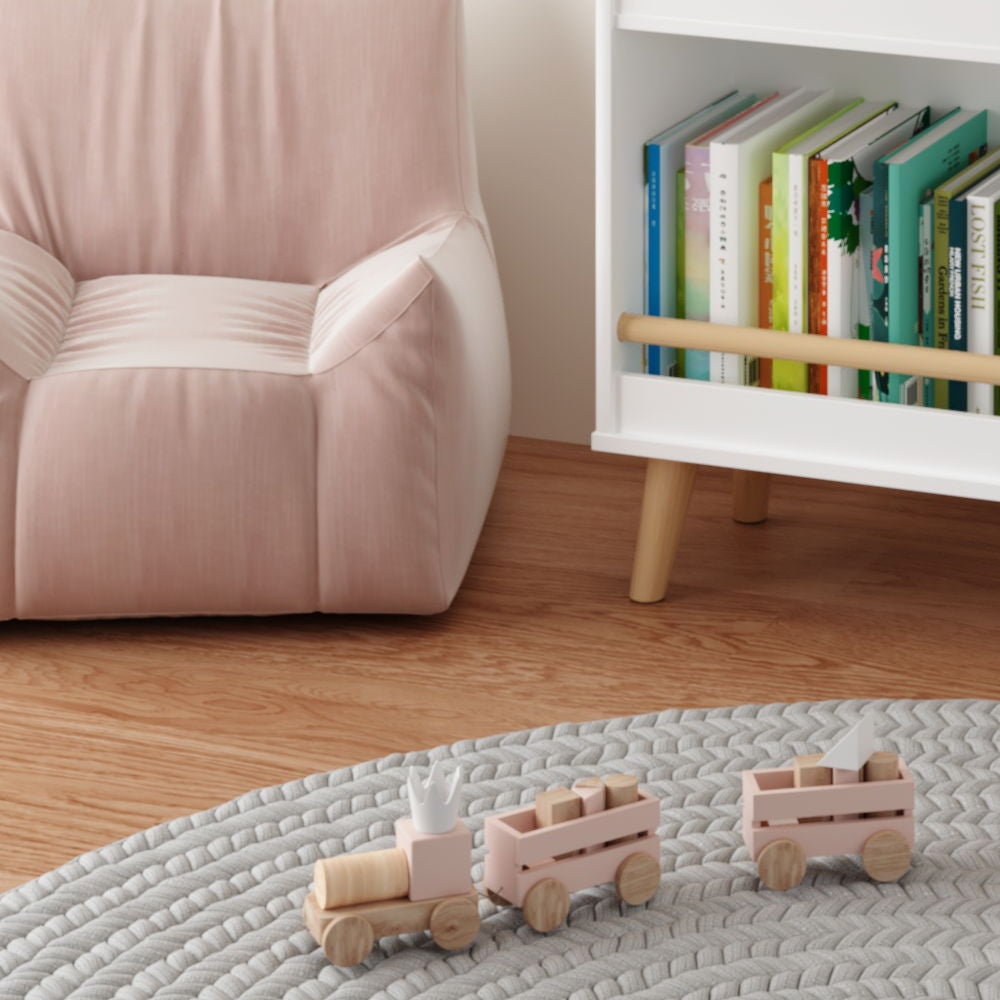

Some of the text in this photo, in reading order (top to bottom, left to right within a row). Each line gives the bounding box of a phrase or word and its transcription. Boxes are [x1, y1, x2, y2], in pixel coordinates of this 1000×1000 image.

[937, 265, 949, 314] Gardens
[970, 204, 985, 310] LOST FISH
[938, 317, 948, 328] in
[954, 247, 962, 340] NEW URBAN HOUSING
